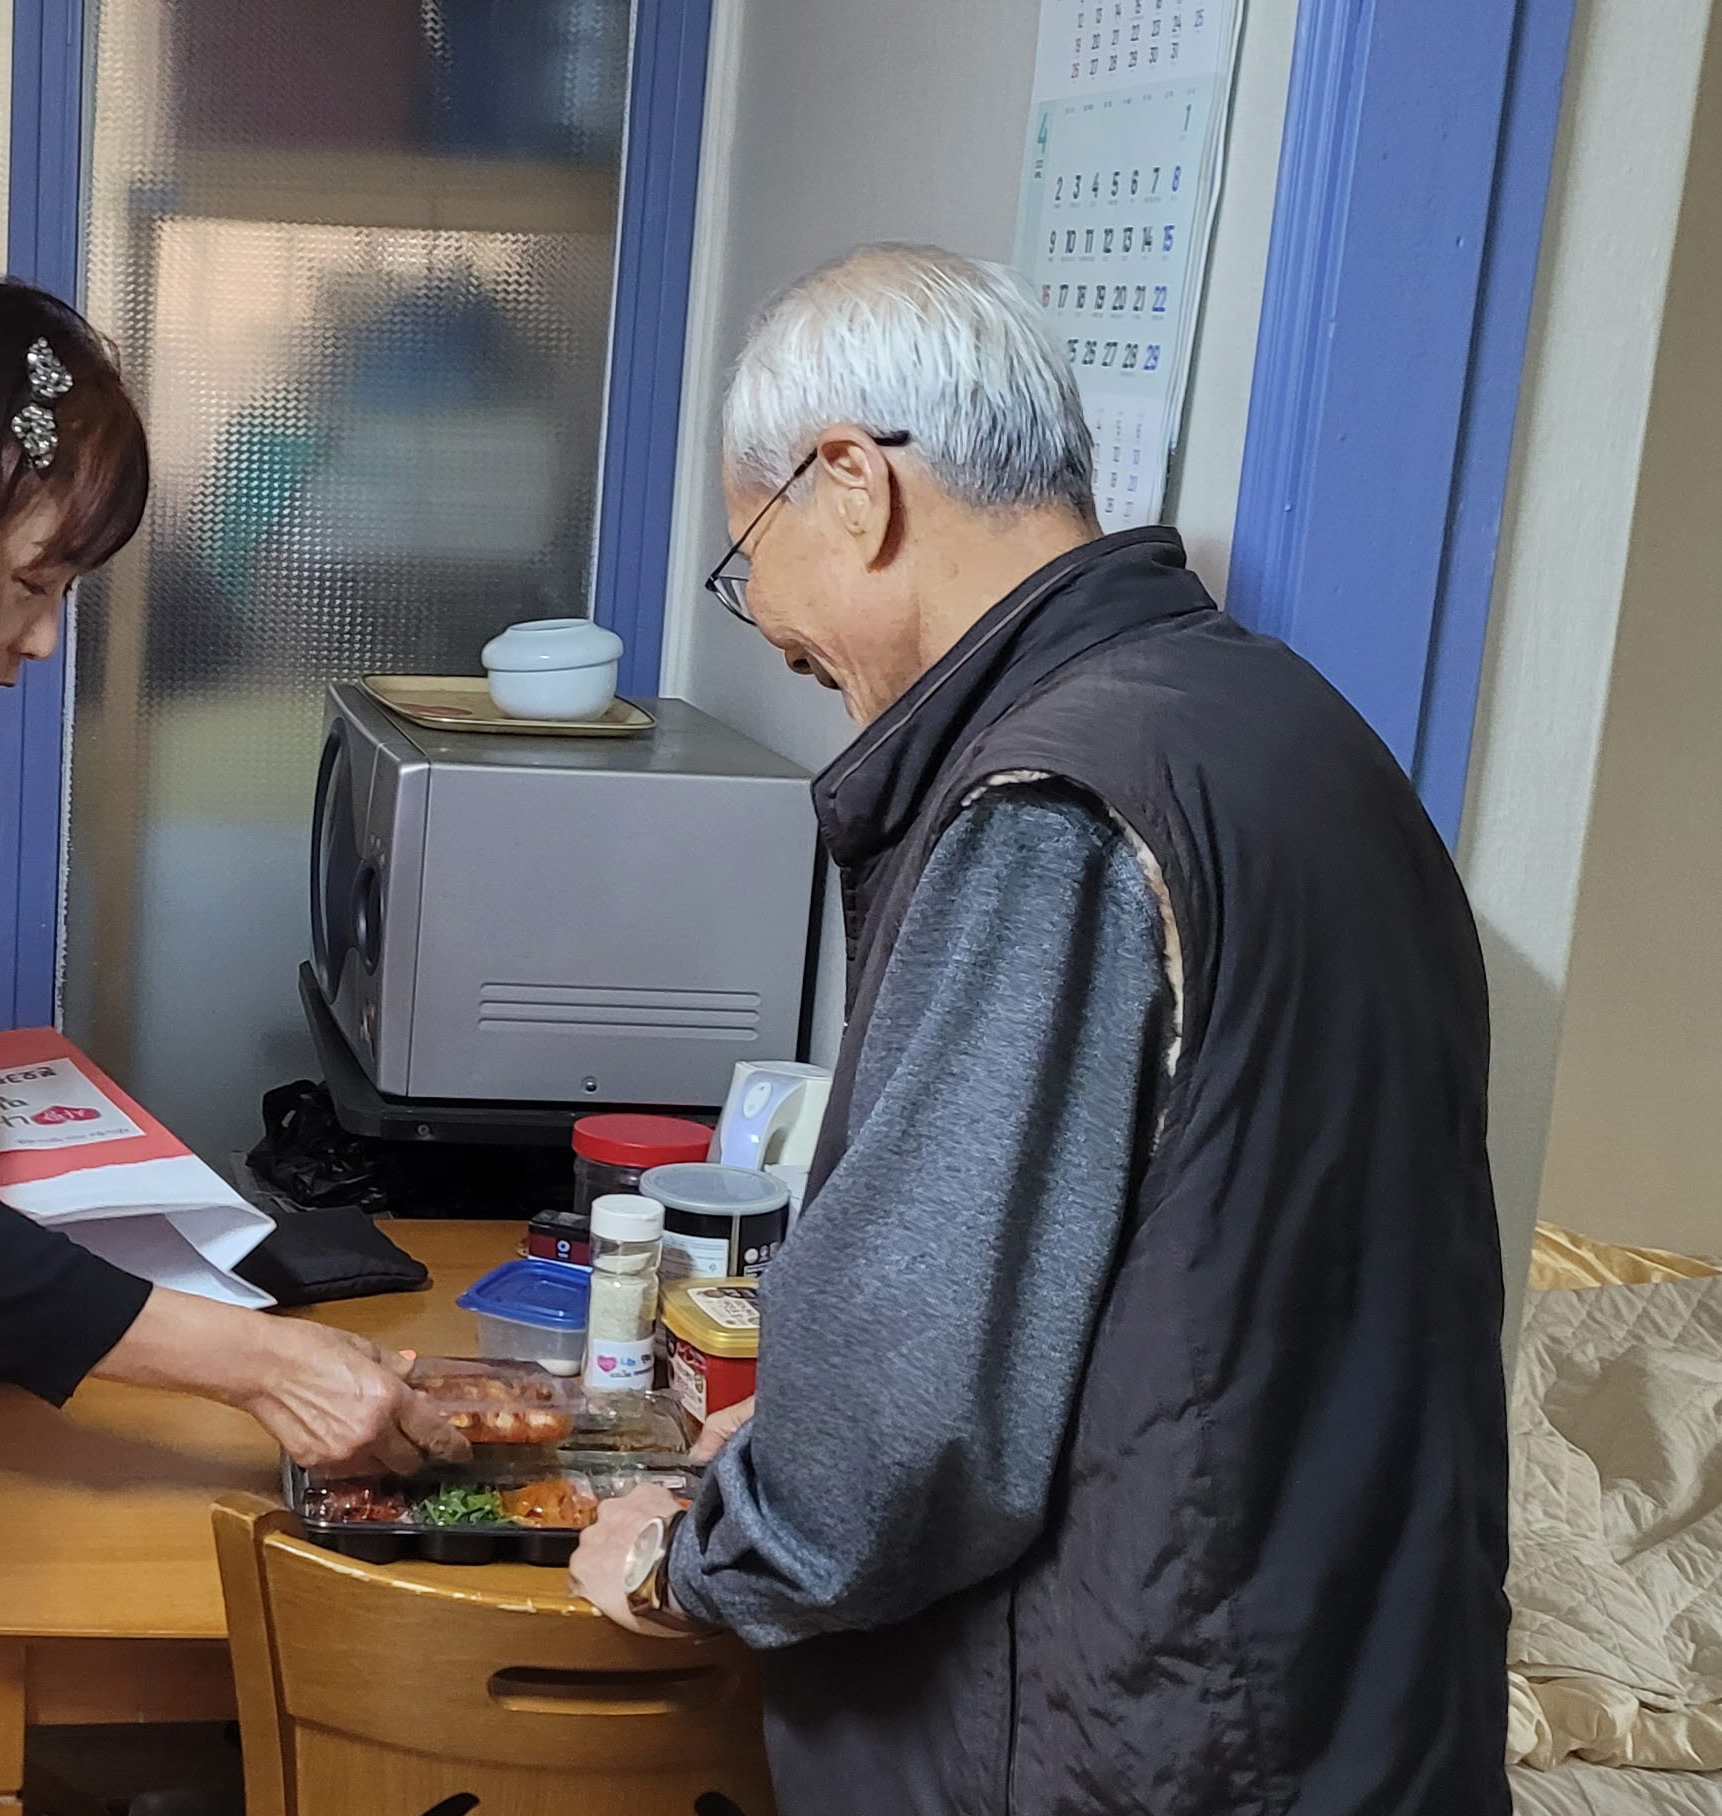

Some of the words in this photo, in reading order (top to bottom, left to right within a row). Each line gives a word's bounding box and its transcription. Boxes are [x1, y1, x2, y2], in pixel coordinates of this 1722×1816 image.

[1184, 103, 1192, 132] 1
[1037, 112, 1048, 153] 4
[1055, 176, 1063, 201] 2
[1073, 174, 1082, 200] 3
[1092, 172, 1099, 198] 4
[1111, 171, 1120, 197] 5
[1131, 169, 1139, 195] 6
[1151, 167, 1161, 194] 7
[1172, 165, 1181, 192] 8
[1048, 230, 1056, 254] 9
[1065, 230, 1076, 253] 10
[1085, 229, 1094, 253] 11
[1103, 228, 1114, 253] 12
[1122, 227, 1134, 252] 13
[1141, 226, 1153, 252] 14
[1163, 225, 1175, 252] 15
[1058, 284, 1069, 308] 17
[1076, 285, 1087, 309] 18
[1094, 285, 1106, 309] 19
[1112, 285, 1127, 311] 20
[1133, 285, 1146, 311] 21
[1152, 286, 1167, 312] 22
[1081, 340, 1097, 365] 26
[1101, 341, 1118, 367] 27
[1122, 343, 1138, 368] 28
[1143, 344, 1160, 370] 29
